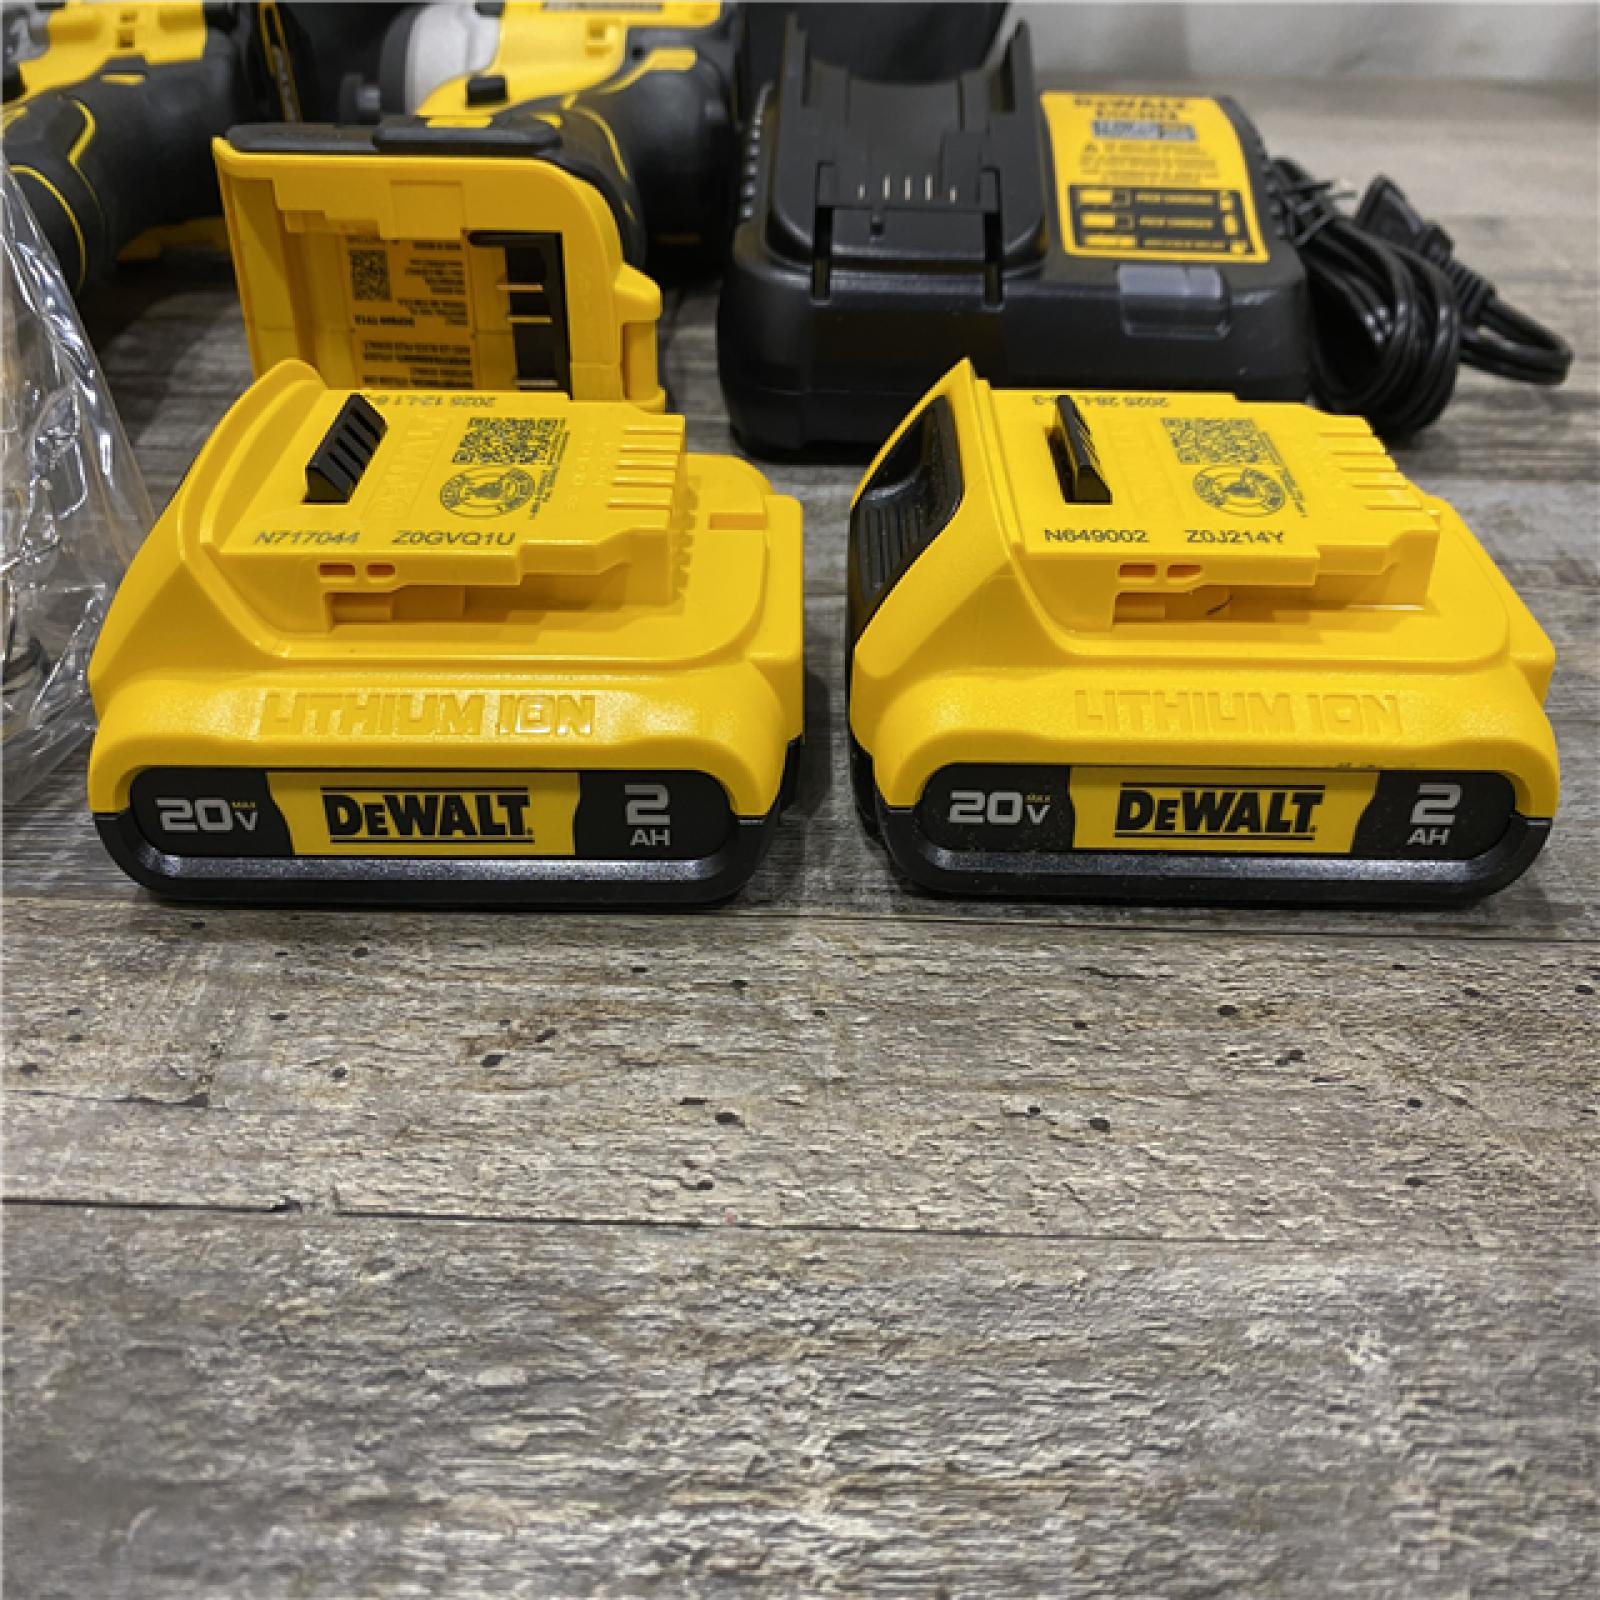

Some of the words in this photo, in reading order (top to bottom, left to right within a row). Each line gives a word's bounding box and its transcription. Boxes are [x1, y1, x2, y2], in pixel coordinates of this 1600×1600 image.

[254, 530, 360, 546] N717044
[1044, 529, 1149, 544] N649002
[257, 691, 487, 737] LITHIUM
[496, 693, 596, 737] ION
[1074, 689, 1297, 733] LITHIUM
[1306, 693, 1402, 736] ION
[624, 784, 672, 826] 2
[1410, 784, 1462, 826] 2
[630, 828, 672, 847] AH
[1406, 828, 1450, 846] AH
